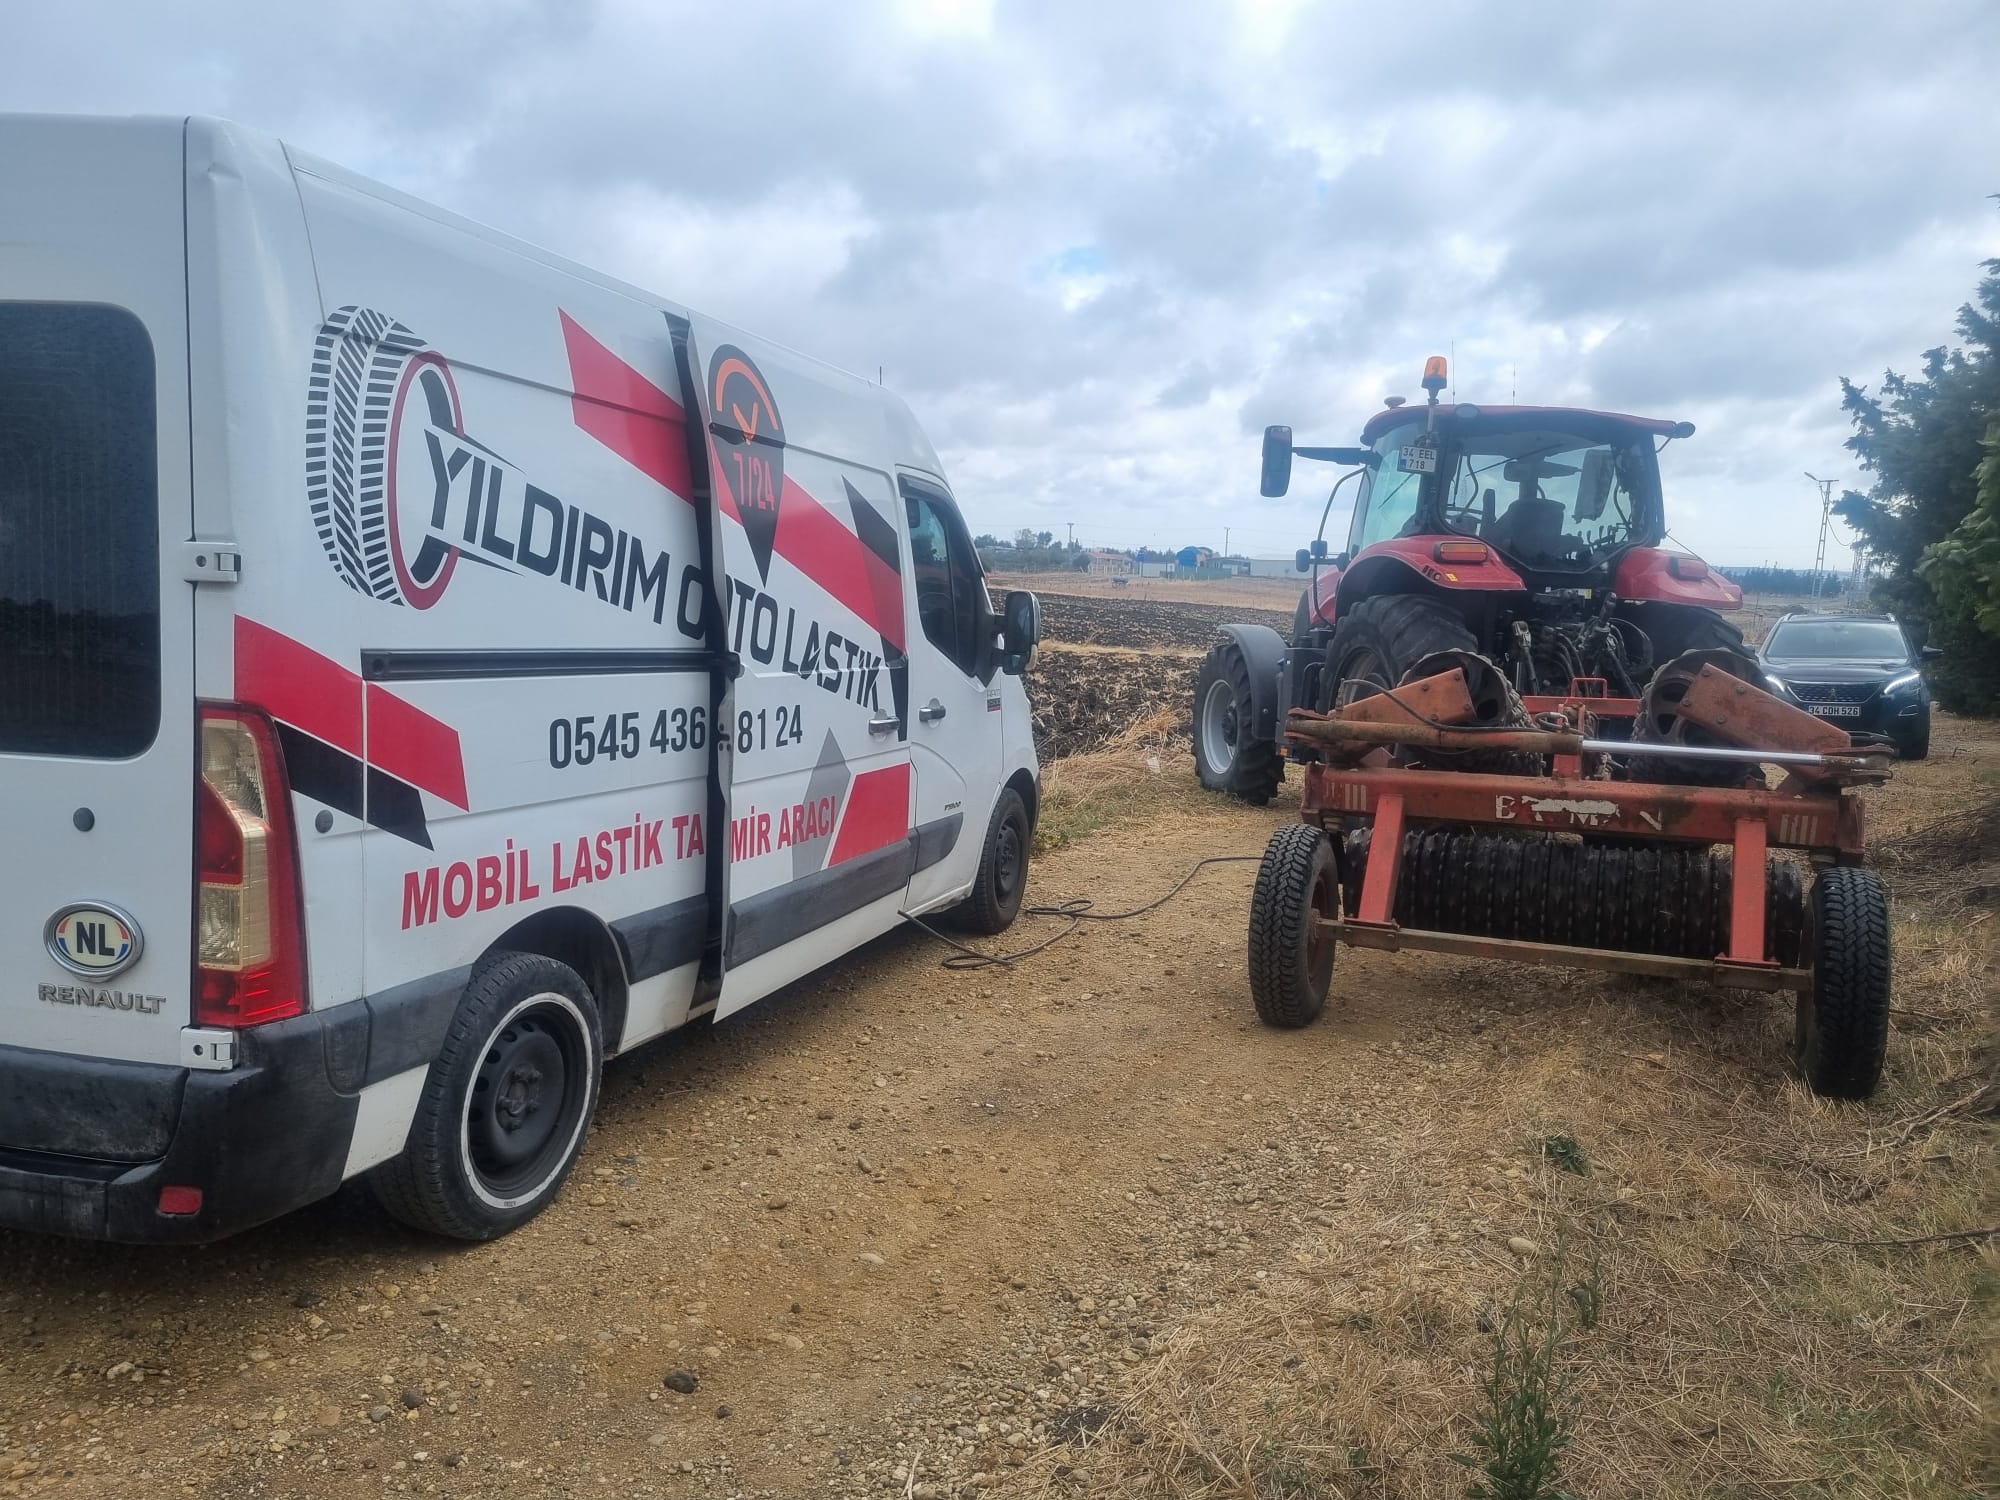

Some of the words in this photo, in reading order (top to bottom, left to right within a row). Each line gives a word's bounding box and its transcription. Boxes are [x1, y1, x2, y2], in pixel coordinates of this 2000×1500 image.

[1403, 447, 1414, 457] 34
[1418, 449, 1434, 460] EEL
[424, 428, 670, 625] YILDIRIM
[1808, 706, 1819, 715] 34
[1842, 706, 1858, 716] 526
[549, 713, 640, 769] 0545
[650, 706, 706, 754] 436
[738, 708, 766, 753] 81
[776, 705, 802, 748] 24
[401, 838, 540, 930] MOBİL
[553, 812, 664, 893] LASTİK
[777, 796, 836, 850] ARACI
[76, 922, 115, 956] NL
[38, 983, 166, 1014] RENAULT
